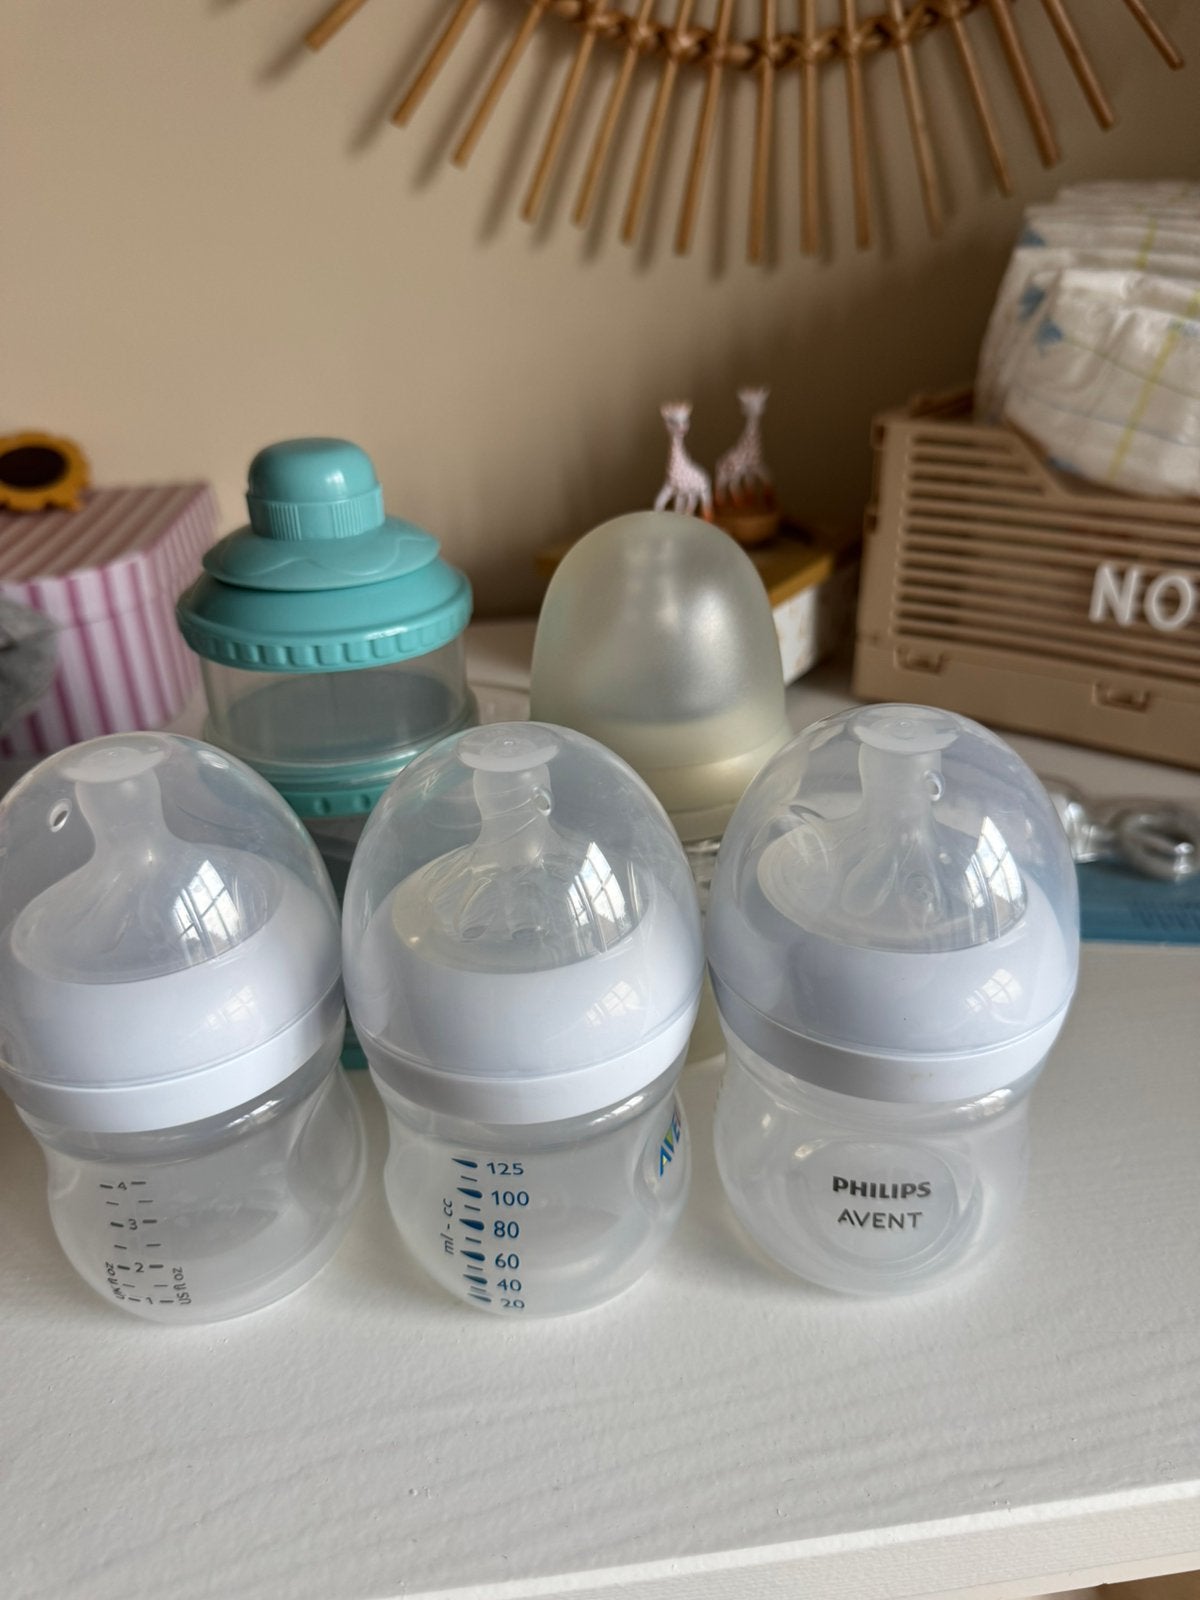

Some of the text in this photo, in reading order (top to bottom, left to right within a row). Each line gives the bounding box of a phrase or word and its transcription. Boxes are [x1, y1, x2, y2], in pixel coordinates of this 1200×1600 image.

[1088, 561, 1196, 632] NO
[486, 1162, 524, 1175] 125
[117, 1181, 127, 1191] 4
[832, 1175, 932, 1199] PHILIPS
[491, 1190, 530, 1206] 100
[443, 1198, 453, 1217] cc
[128, 1218, 138, 1230] 3
[837, 1208, 923, 1229] AVENT
[494, 1220, 520, 1239] 80
[440, 1232, 454, 1255] ml
[134, 1262, 144, 1273] 2
[495, 1253, 520, 1269] 60
[497, 1278, 522, 1292] 40
[176, 1292, 191, 1305] US
[500, 1298, 525, 1309] 20
